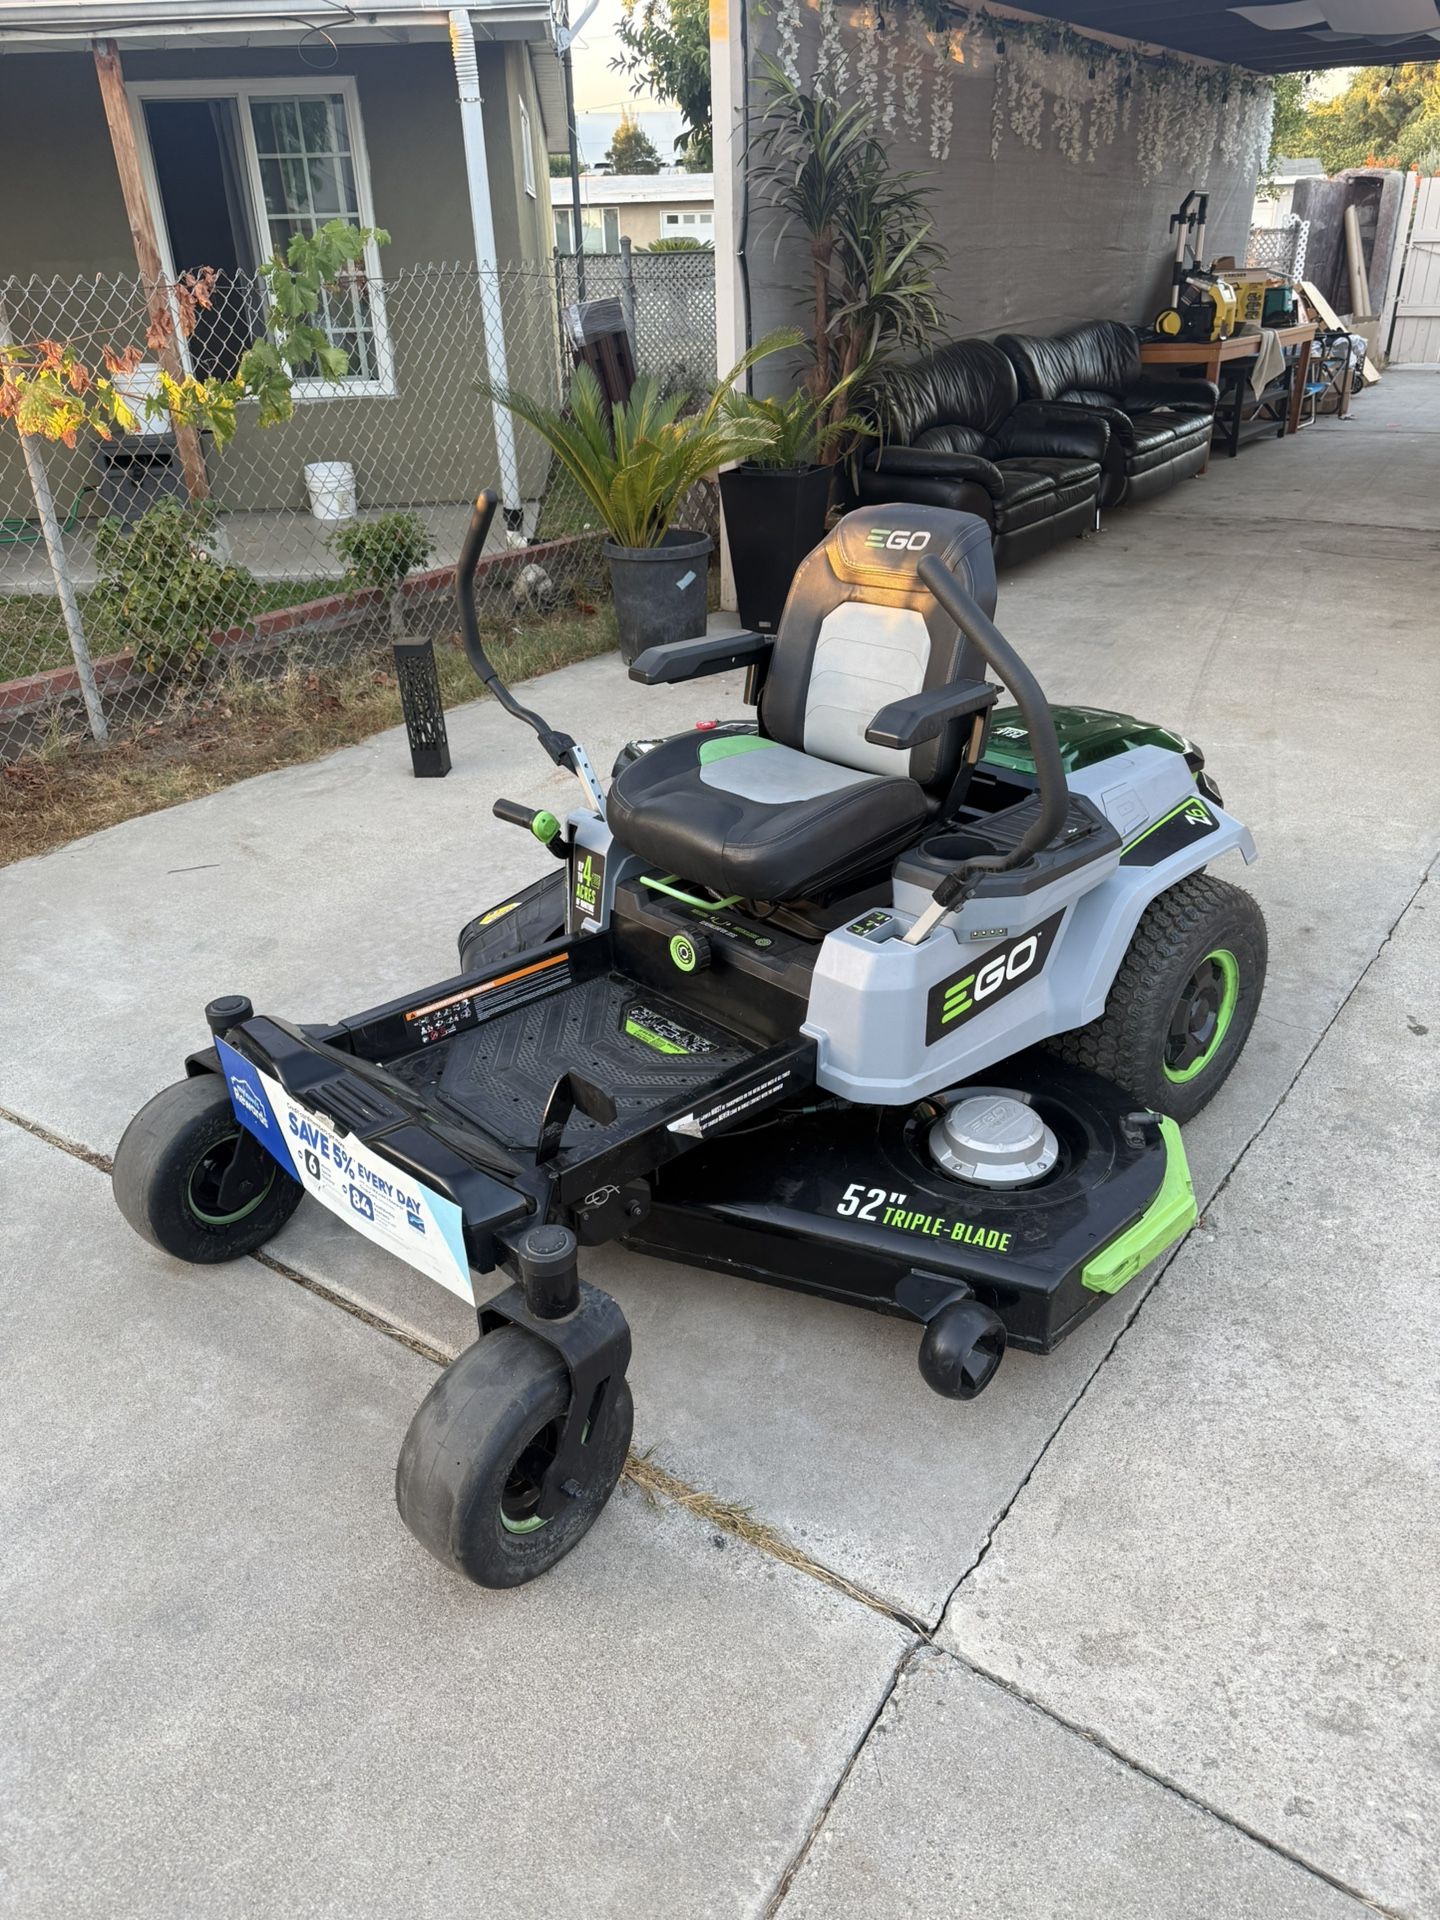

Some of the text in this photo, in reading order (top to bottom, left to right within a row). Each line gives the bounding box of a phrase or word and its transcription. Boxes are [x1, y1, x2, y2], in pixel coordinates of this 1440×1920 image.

[863, 528, 931, 551] EGO
[1184, 808, 1213, 826] Z6
[583, 855, 592, 886] 4
[941, 935, 1038, 1024] EGO
[288, 1111, 330, 1160] SAVE
[357, 1162, 393, 1197] EVERY
[396, 1189, 421, 1215] DAY
[308, 1154, 317, 1175] 6
[352, 1188, 372, 1218] 84
[836, 1183, 907, 1222] 52"
[882, 1206, 1012, 1252] TRIPLE-BLADE
